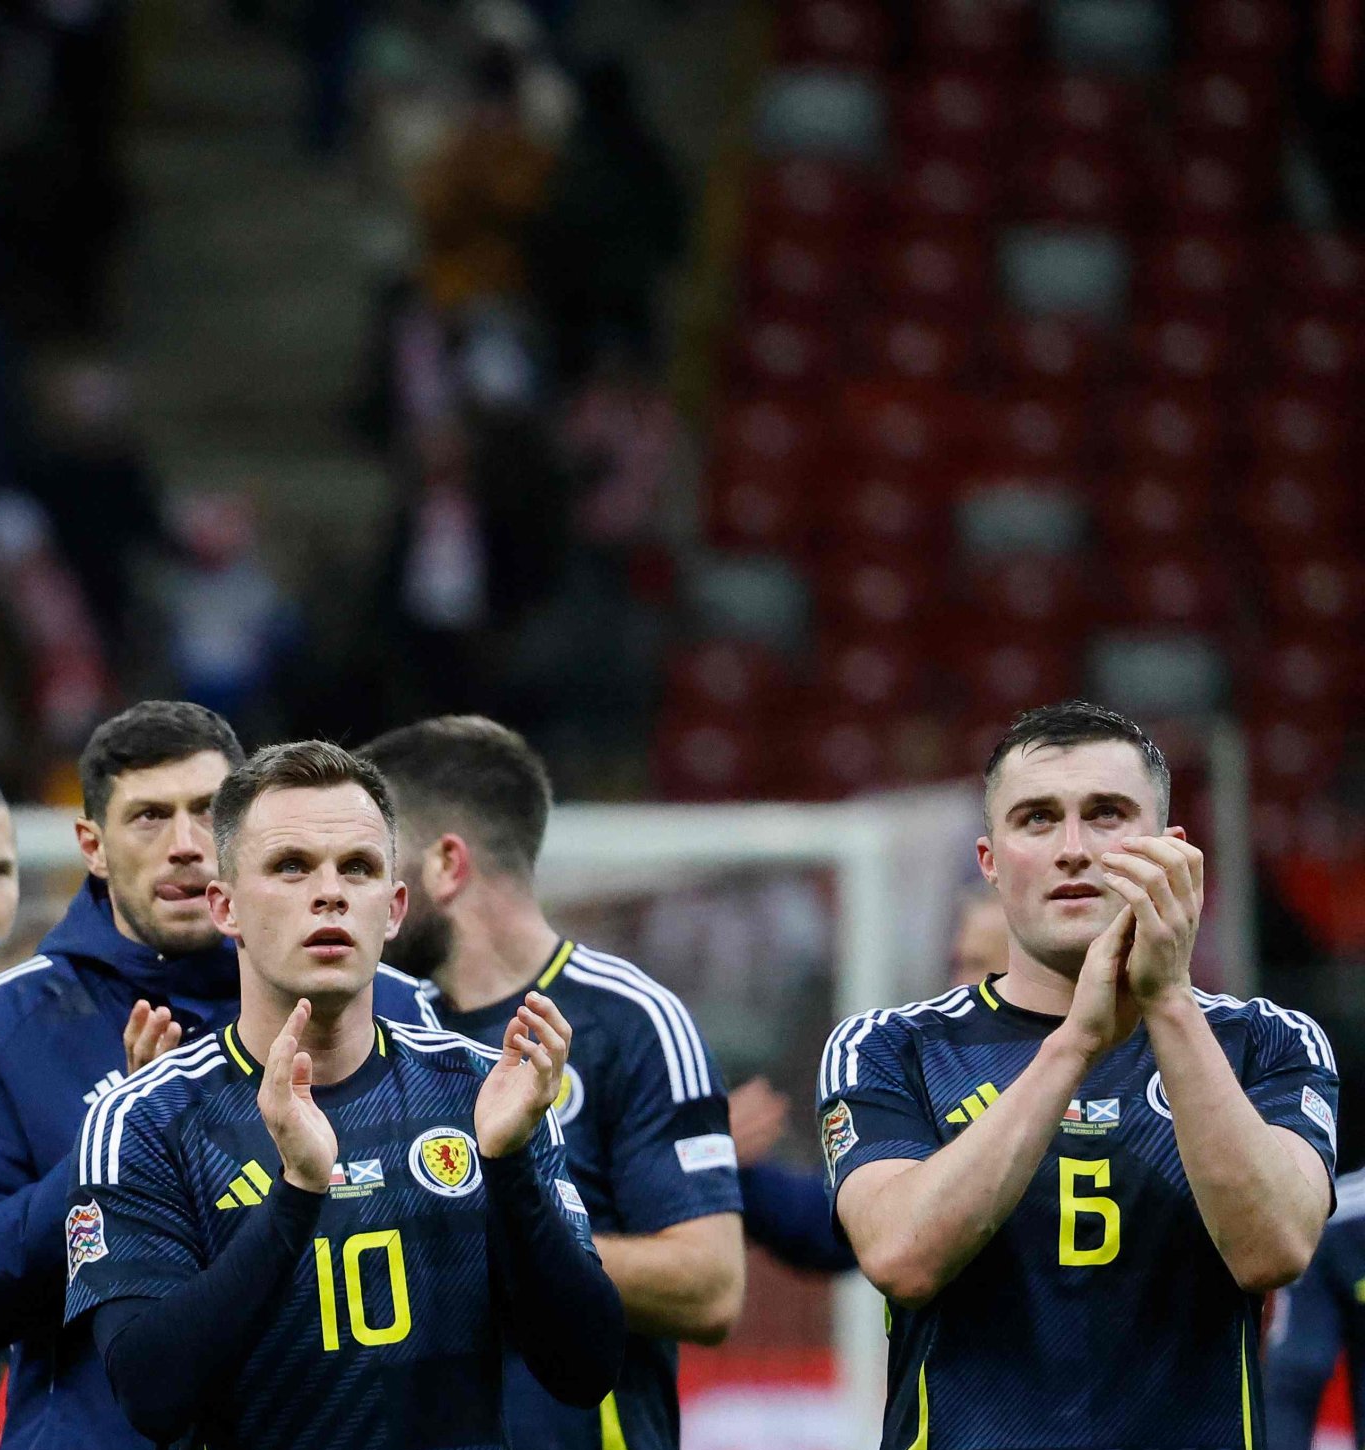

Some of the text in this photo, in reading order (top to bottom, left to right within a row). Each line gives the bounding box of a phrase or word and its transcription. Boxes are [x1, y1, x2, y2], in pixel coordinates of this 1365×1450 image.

[422, 1128, 461, 1141] SCOTLAND
[1059, 1157, 1120, 1267] 6
[315, 1229, 411, 1352] 10
